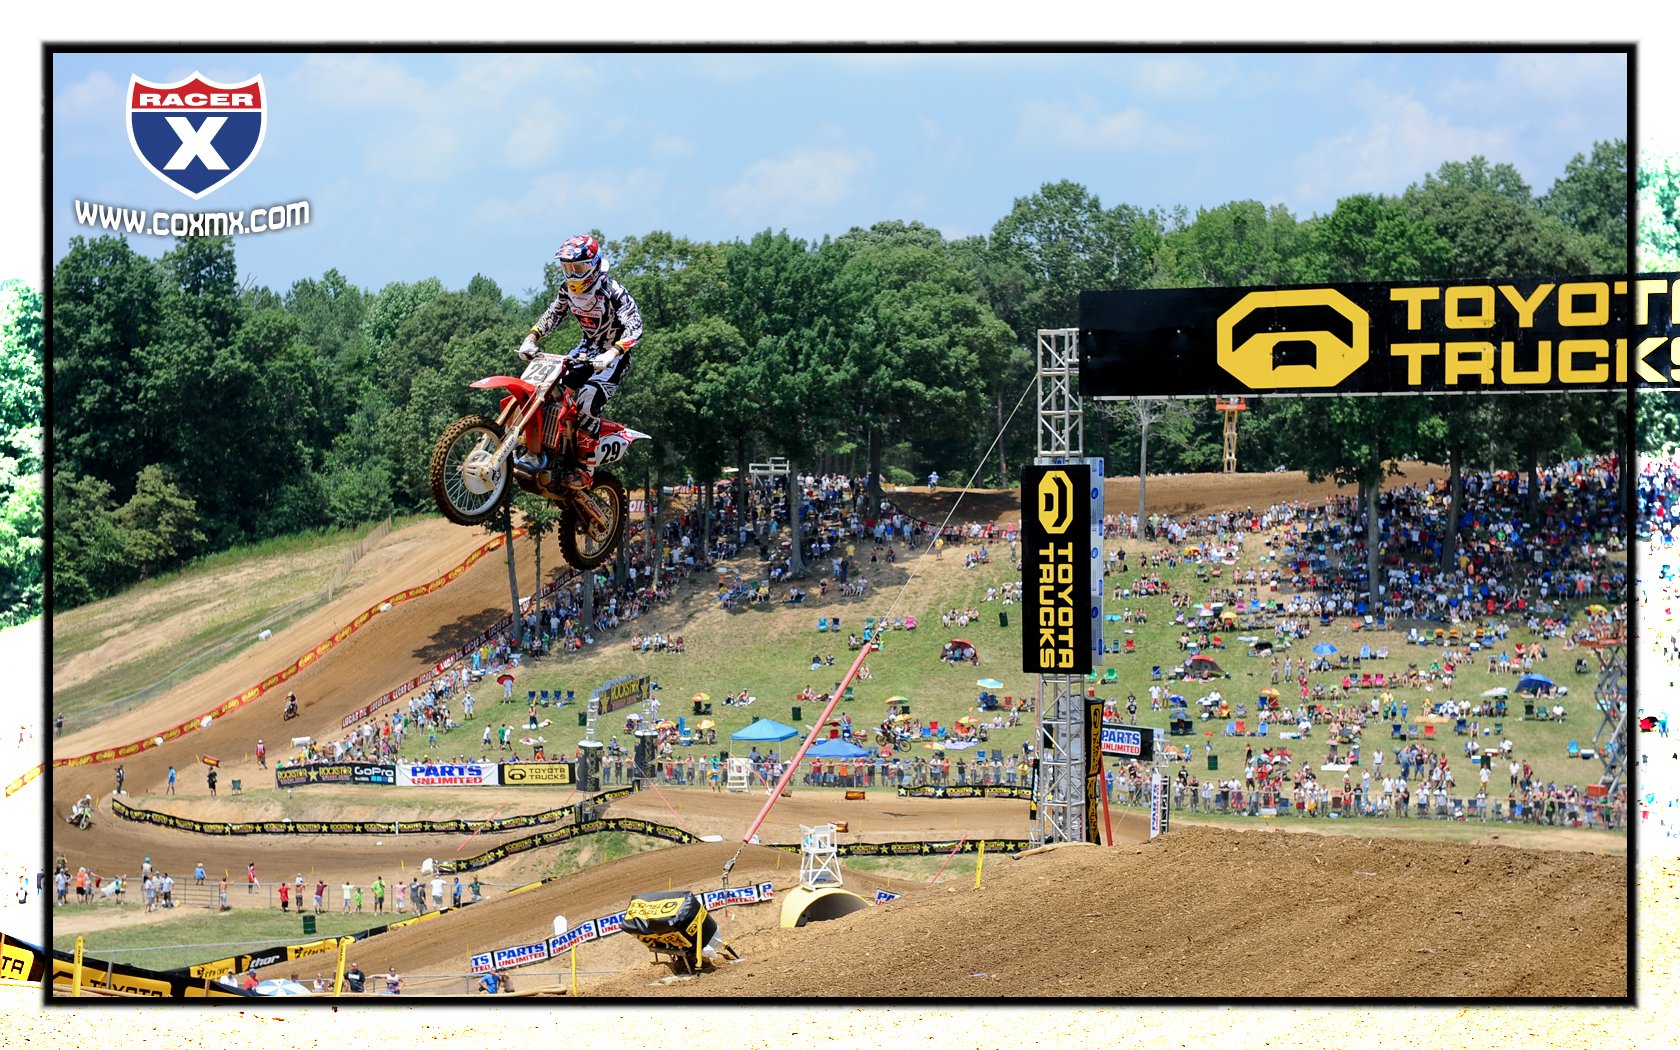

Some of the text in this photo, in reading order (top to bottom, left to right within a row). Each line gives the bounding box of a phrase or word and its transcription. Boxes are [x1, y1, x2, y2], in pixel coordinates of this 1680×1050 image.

[1390, 279, 1680, 330] TOYOT
[525, 363, 557, 383] 29
[600, 440, 621, 465] 29
[1039, 542, 1055, 669] TRUCKS
[1057, 542, 1074, 669] TOYOTA
[1102, 728, 1141, 745] PARTS
[1102, 743, 1141, 755] UNLIMITED
[277, 768, 308, 780] ROCKSTAR
[319, 766, 353, 776] ROCKSTAR
[354, 766, 395, 777] GoPro
[411, 765, 482, 777] PARTS
[411, 776, 483, 785] UNLIMITED
[707, 888, 754, 902] PARTS
[599, 911, 627, 928] PAR
[551, 922, 593, 948] PARTS
[496, 943, 545, 961] PARTS
[498, 951, 545, 967] UNLIMITED
[250, 955, 281, 968] thor
